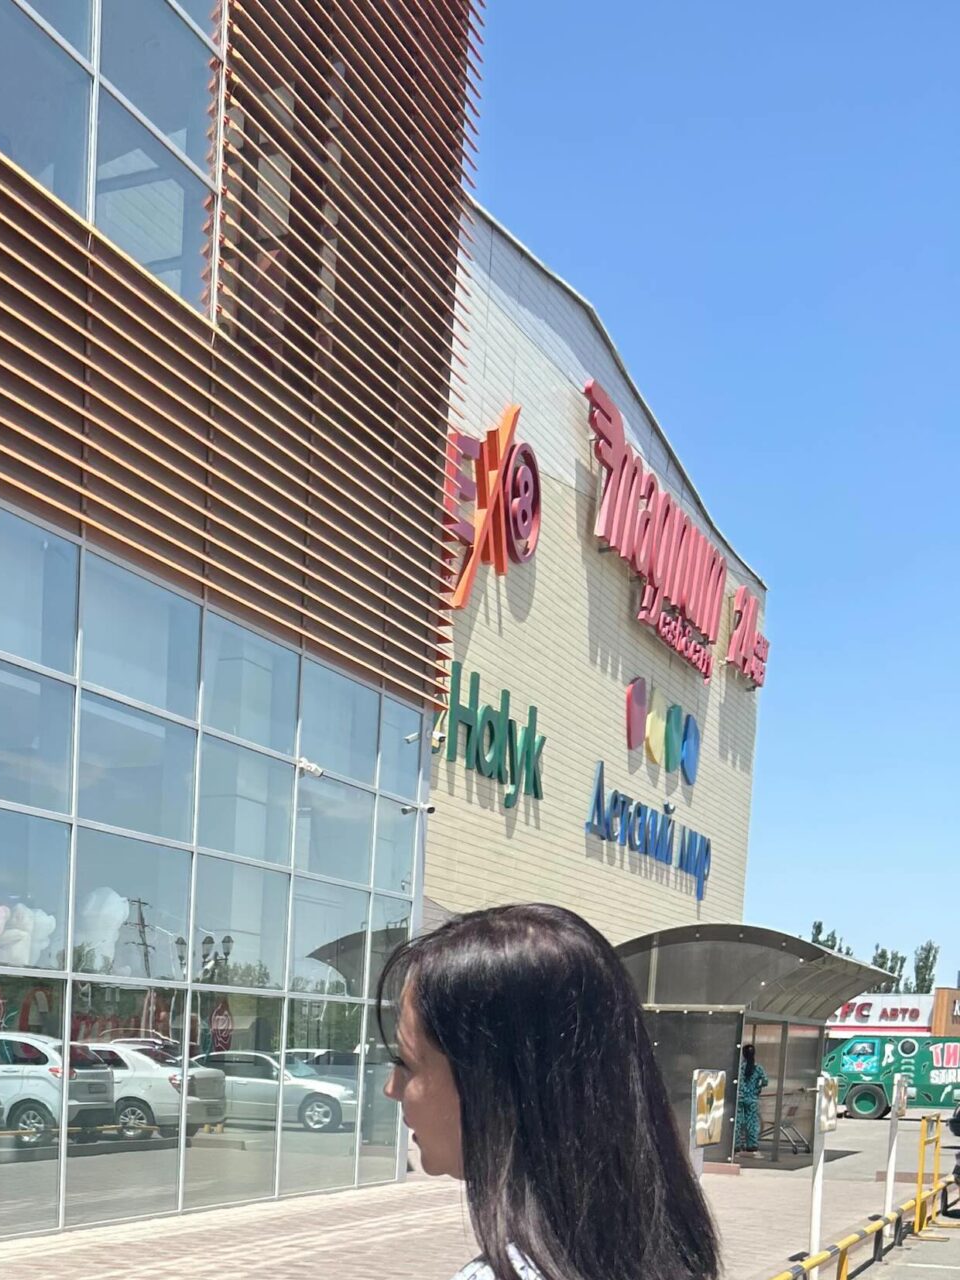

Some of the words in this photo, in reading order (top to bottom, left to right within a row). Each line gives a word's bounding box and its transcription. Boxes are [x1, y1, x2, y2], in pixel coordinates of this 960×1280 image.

[445, 660, 547, 809] Halyk
[585, 760, 676, 866] Детский
[829, 1002, 873, 1022] FC
[929, 1042, 960, 1068] TH
